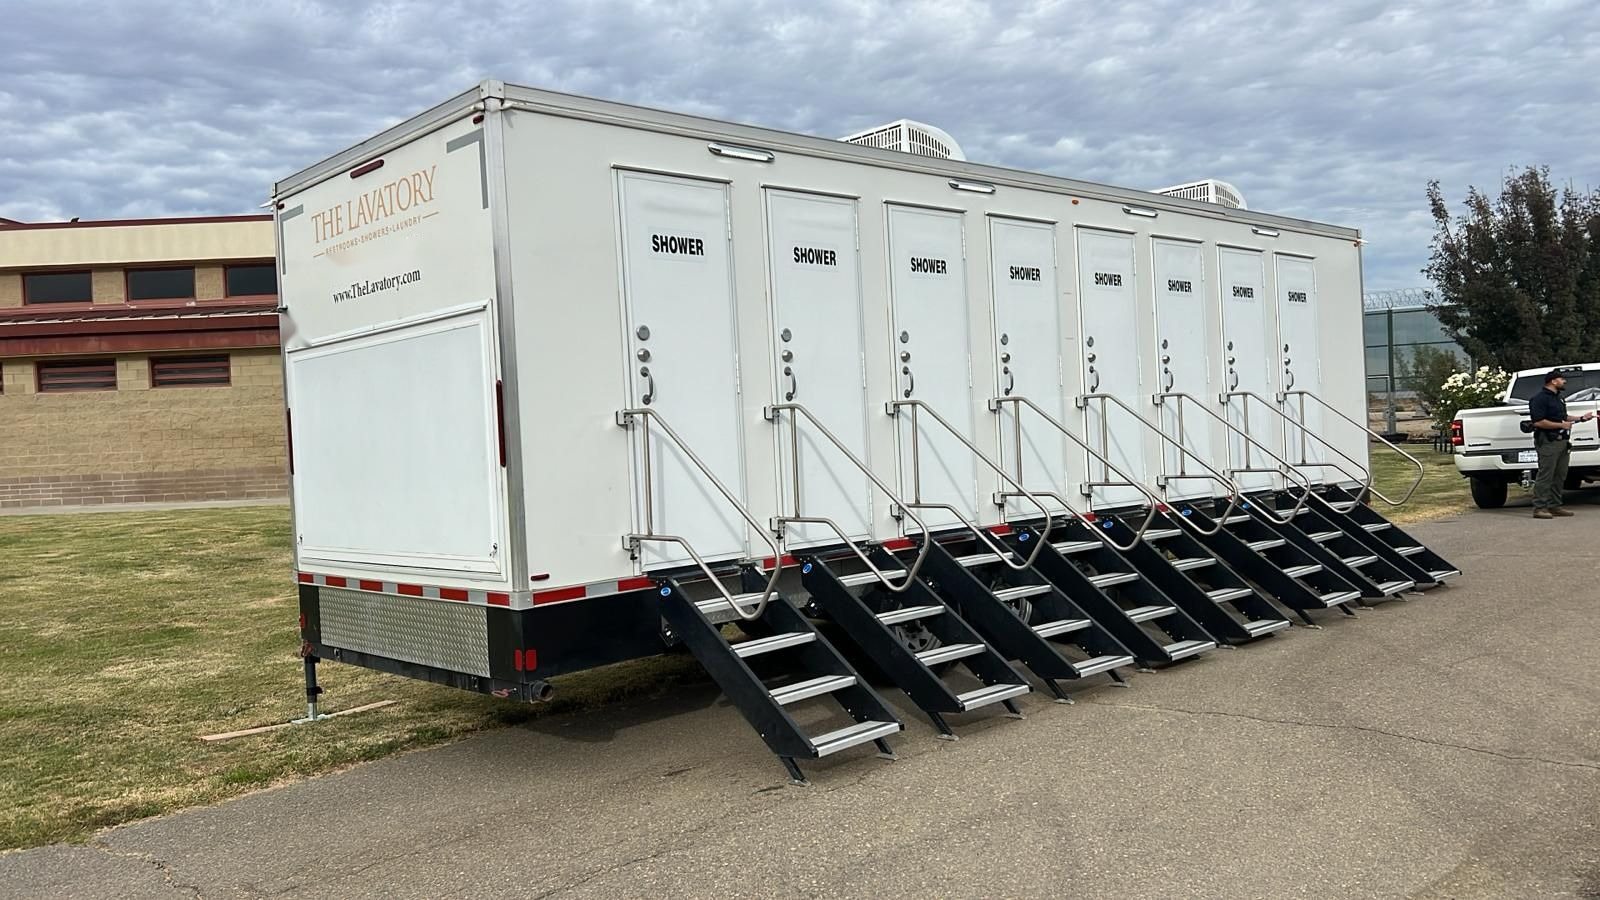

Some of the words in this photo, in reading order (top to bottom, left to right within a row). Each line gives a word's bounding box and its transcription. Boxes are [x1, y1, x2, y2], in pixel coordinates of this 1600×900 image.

[311, 204, 344, 244] THE
[347, 165, 437, 231] LAVATORY
[651, 234, 704, 256] SHOWER
[793, 246, 837, 266] SHOWER
[910, 257, 947, 274] SHOWER
[1009, 265, 1041, 281] SHOWER
[332, 269, 421, 304] www.TheLavatory.com
[1094, 272, 1122, 287] SHOWER
[1167, 279, 1192, 293] SHOWER
[1232, 285, 1254, 299] SHOWER
[1288, 291, 1307, 303] SHOWER
